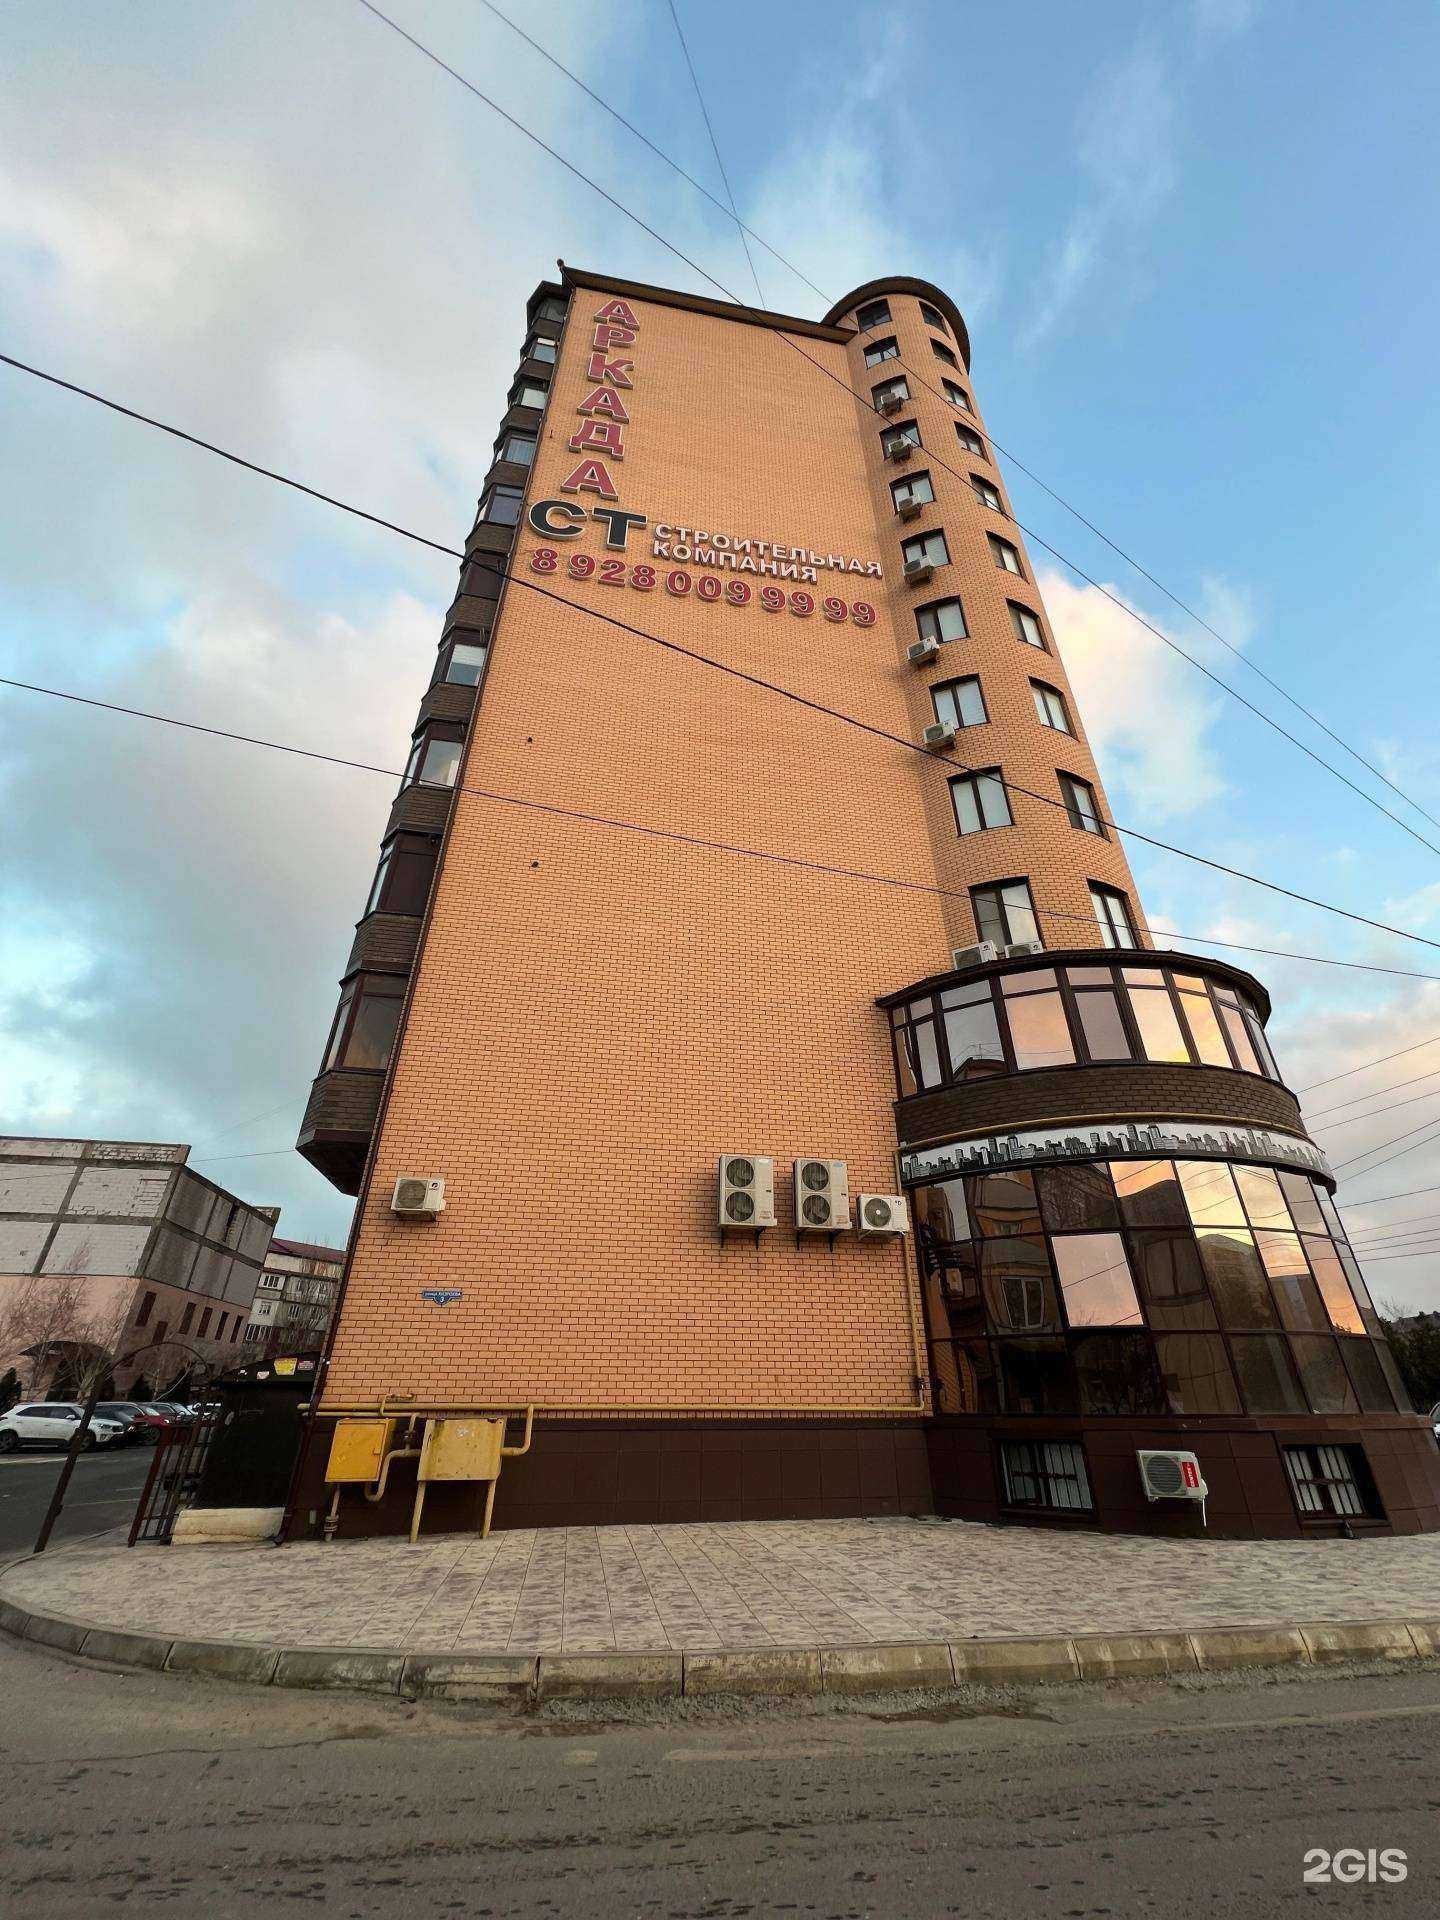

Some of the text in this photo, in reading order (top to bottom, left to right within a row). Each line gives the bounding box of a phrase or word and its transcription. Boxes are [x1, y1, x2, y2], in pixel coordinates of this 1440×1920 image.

[560, 299, 640, 501] АРКАДА
[528, 499, 648, 552] СТ
[654, 523, 884, 580] СТРОИТЕЛЬНАЯ
[653, 539, 818, 585] КОМПАНИЯ
